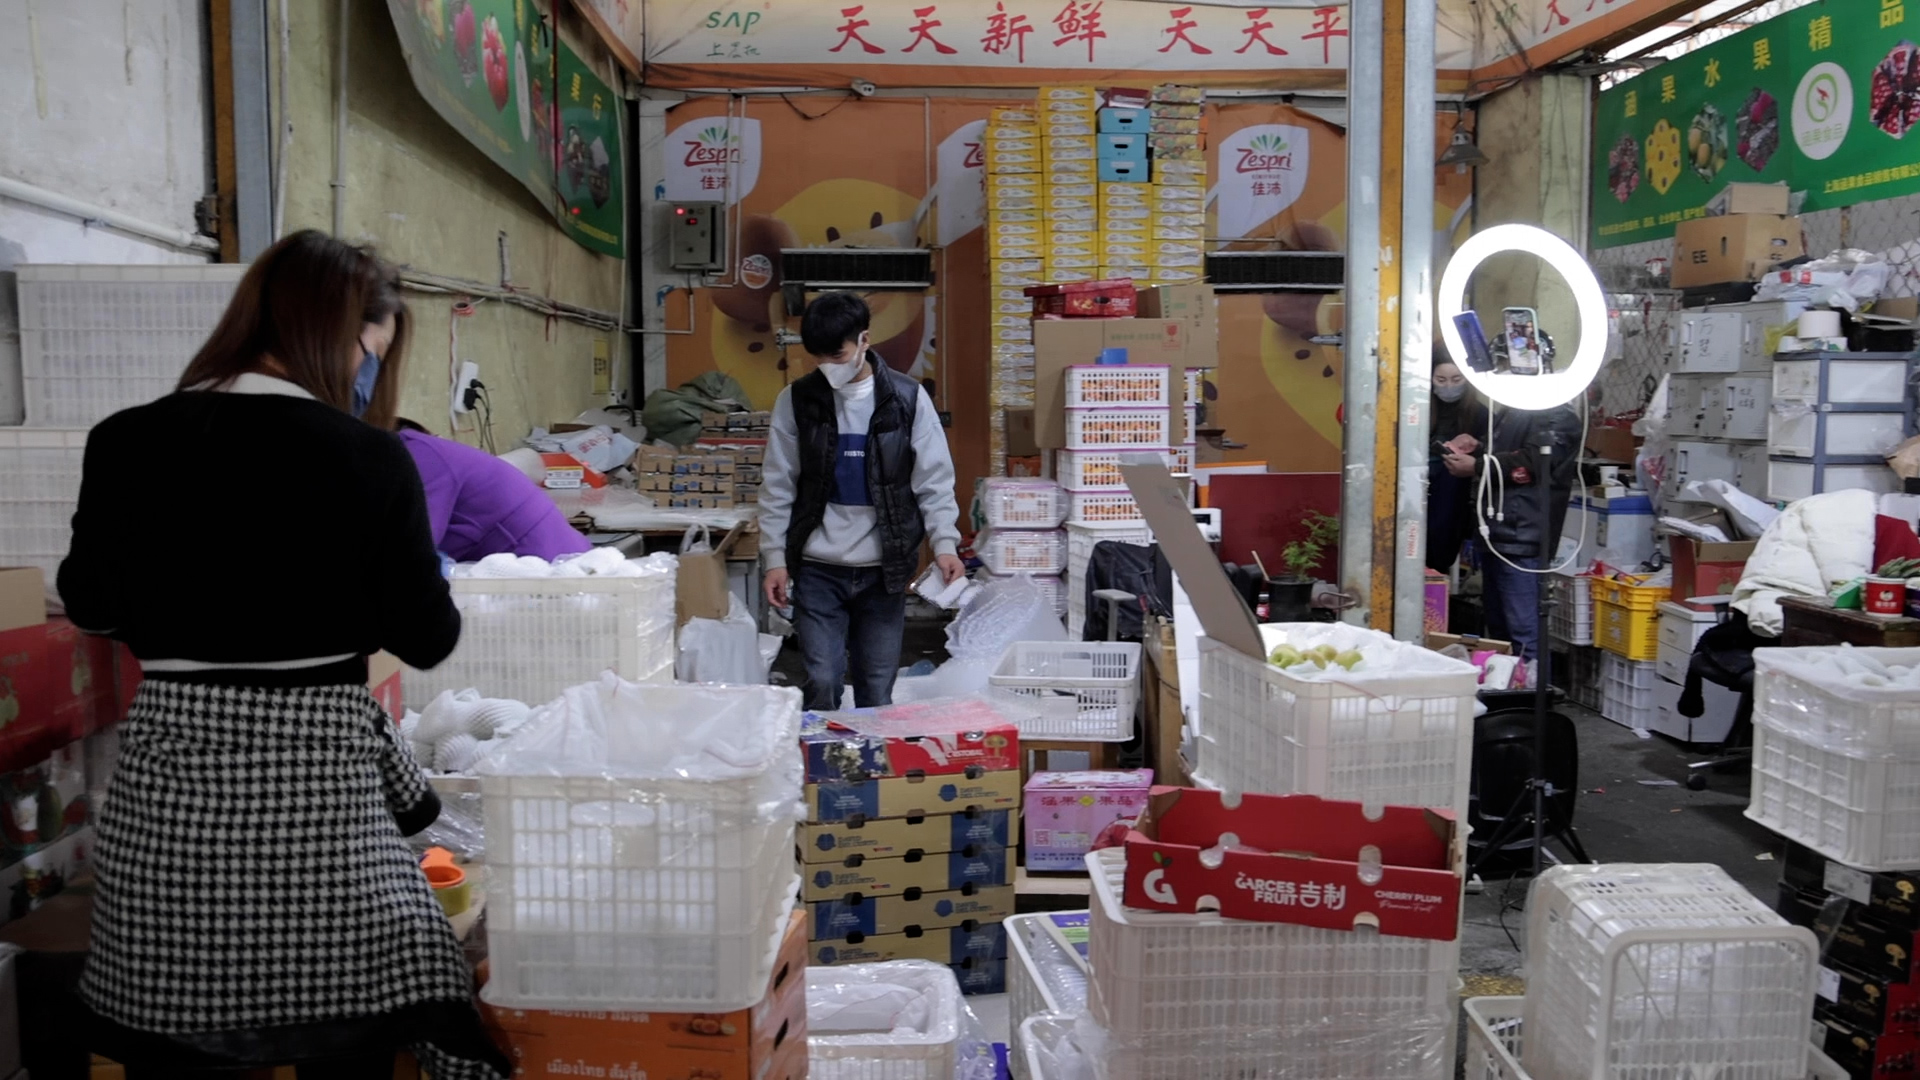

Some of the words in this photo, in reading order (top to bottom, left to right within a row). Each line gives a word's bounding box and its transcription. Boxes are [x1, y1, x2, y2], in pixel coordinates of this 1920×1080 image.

[706, 11, 761, 35] SAP
[828, 5, 1107, 63] 天天新鲜
[684, 140, 746, 167] Zespr
[1236, 148, 1292, 174] Zespri
[1254, 890, 1298, 906] FRUIT
[1374, 889, 1412, 901] CHERRY
[1414, 893, 1442, 904] PLUM
